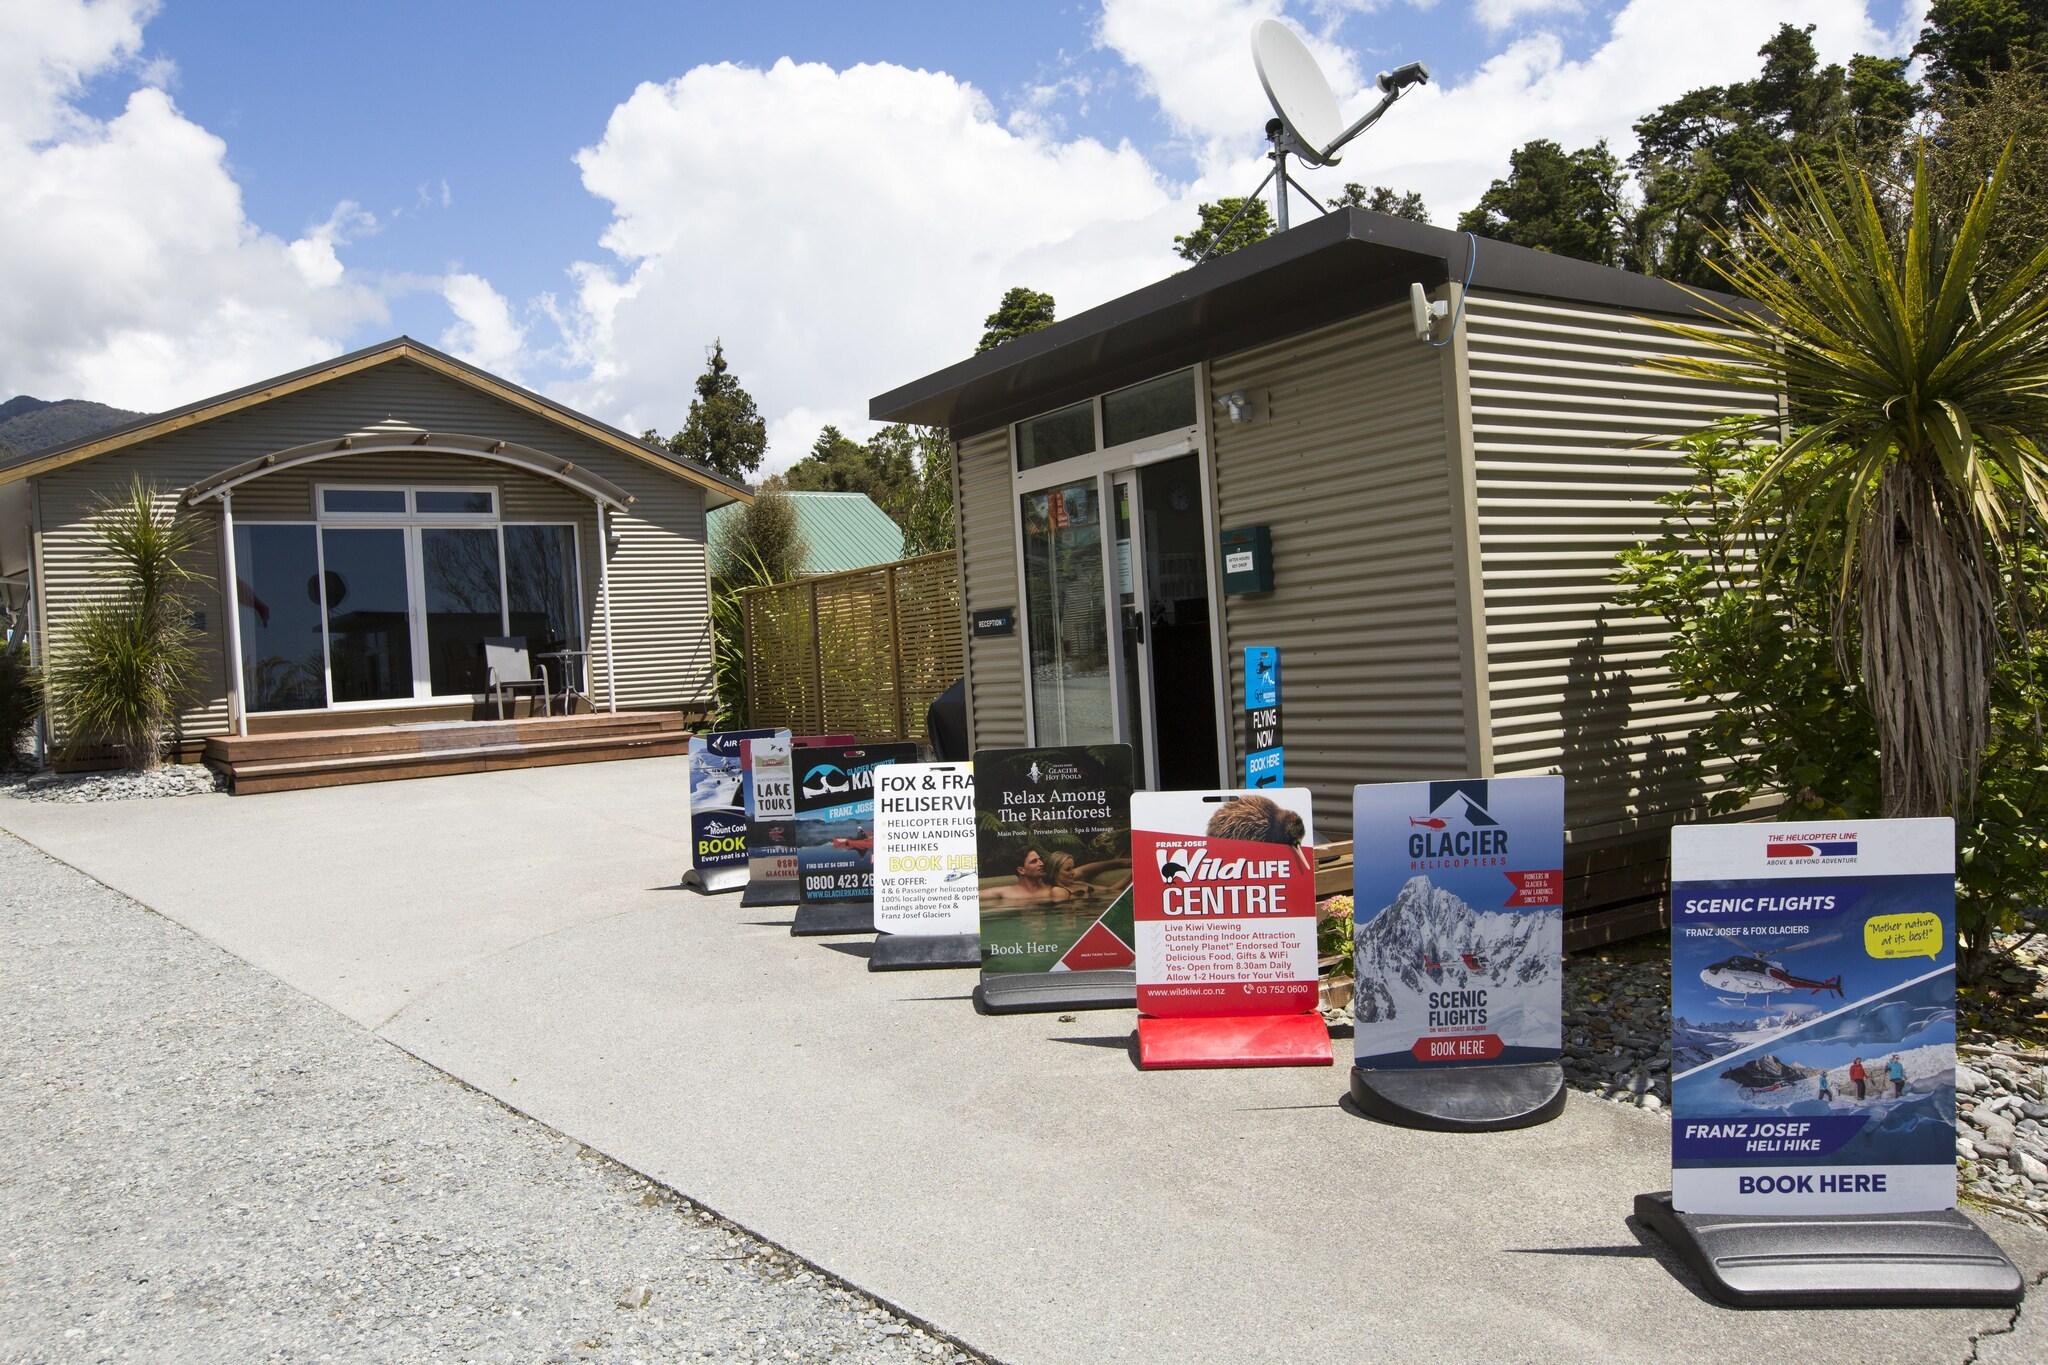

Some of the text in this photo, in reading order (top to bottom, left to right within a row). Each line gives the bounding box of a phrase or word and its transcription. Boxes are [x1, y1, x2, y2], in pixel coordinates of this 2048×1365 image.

[1254, 709, 1276, 729] FLYING
[1256, 730, 1274, 750] NOW
[847, 765, 870, 776] GLACIER
[1250, 754, 1280, 773] BOOK HERE
[757, 783, 790, 798] LAKE
[882, 776, 916, 792] FOX
[922, 776, 936, 790] &
[758, 798, 792, 810] TOURS
[882, 796, 974, 812] HELISERVI
[1003, 790, 1106, 805] Relax Among
[830, 806, 853, 818] FRANZ
[998, 806, 1112, 822] The Rainforest
[888, 817, 976, 828] HELICOPTER FLIG
[888, 830, 975, 840] SNOW LANDINGS
[1768, 832, 1858, 842] THE HELICOPTER LINE
[698, 836, 746, 855] BOOK
[888, 843, 938, 852] HELIHIKES
[1408, 830, 1508, 858] GLACIER
[890, 856, 942, 872] BOOK
[1410, 857, 1506, 870] HELICOPTERS
[806, 876, 834, 890] 0800
[838, 874, 858, 888] 423
[898, 878, 927, 886] OFFER:
[1162, 884, 1286, 916] CENTRE
[1684, 896, 1836, 914] SCENIC FLIGHTS
[1164, 924, 1183, 932] Live
[1206, 923, 1242, 932] Viewing
[1686, 926, 1810, 937] FRANZ JOSEF & FOX GLACIERS
[1869, 918, 1934, 934] "Mother nature
[1165, 934, 1218, 942] Outstanding
[1881, 935, 1892, 946] at
[1894, 934, 1906, 944] its
[990, 942, 1058, 956] Book Here
[1166, 941, 1301, 952] "Lonely Planet" Endorsed Tour
[1166, 953, 1206, 962] Delicious
[1208, 952, 1234, 961] Food,
[1166, 964, 1185, 972] Yes-
[1187, 963, 1210, 972] Open
[1270, 962, 1292, 970] Daily
[1208, 972, 1236, 980] Hours
[1148, 988, 1226, 996] www.wildkiwi.co.nz
[1270, 986, 1284, 994] 752
[1286, 985, 1308, 993] 0600
[1429, 990, 1488, 1008] SCENIC
[1429, 1009, 1488, 1026] FLIGHTS
[1431, 1040, 1485, 1056] BOOK HERE
[1685, 1123, 1810, 1139] FRANZ JOSEF
[1746, 1139, 1821, 1152] HELI HIKE
[1740, 1174, 1887, 1194] BOOK HERE
